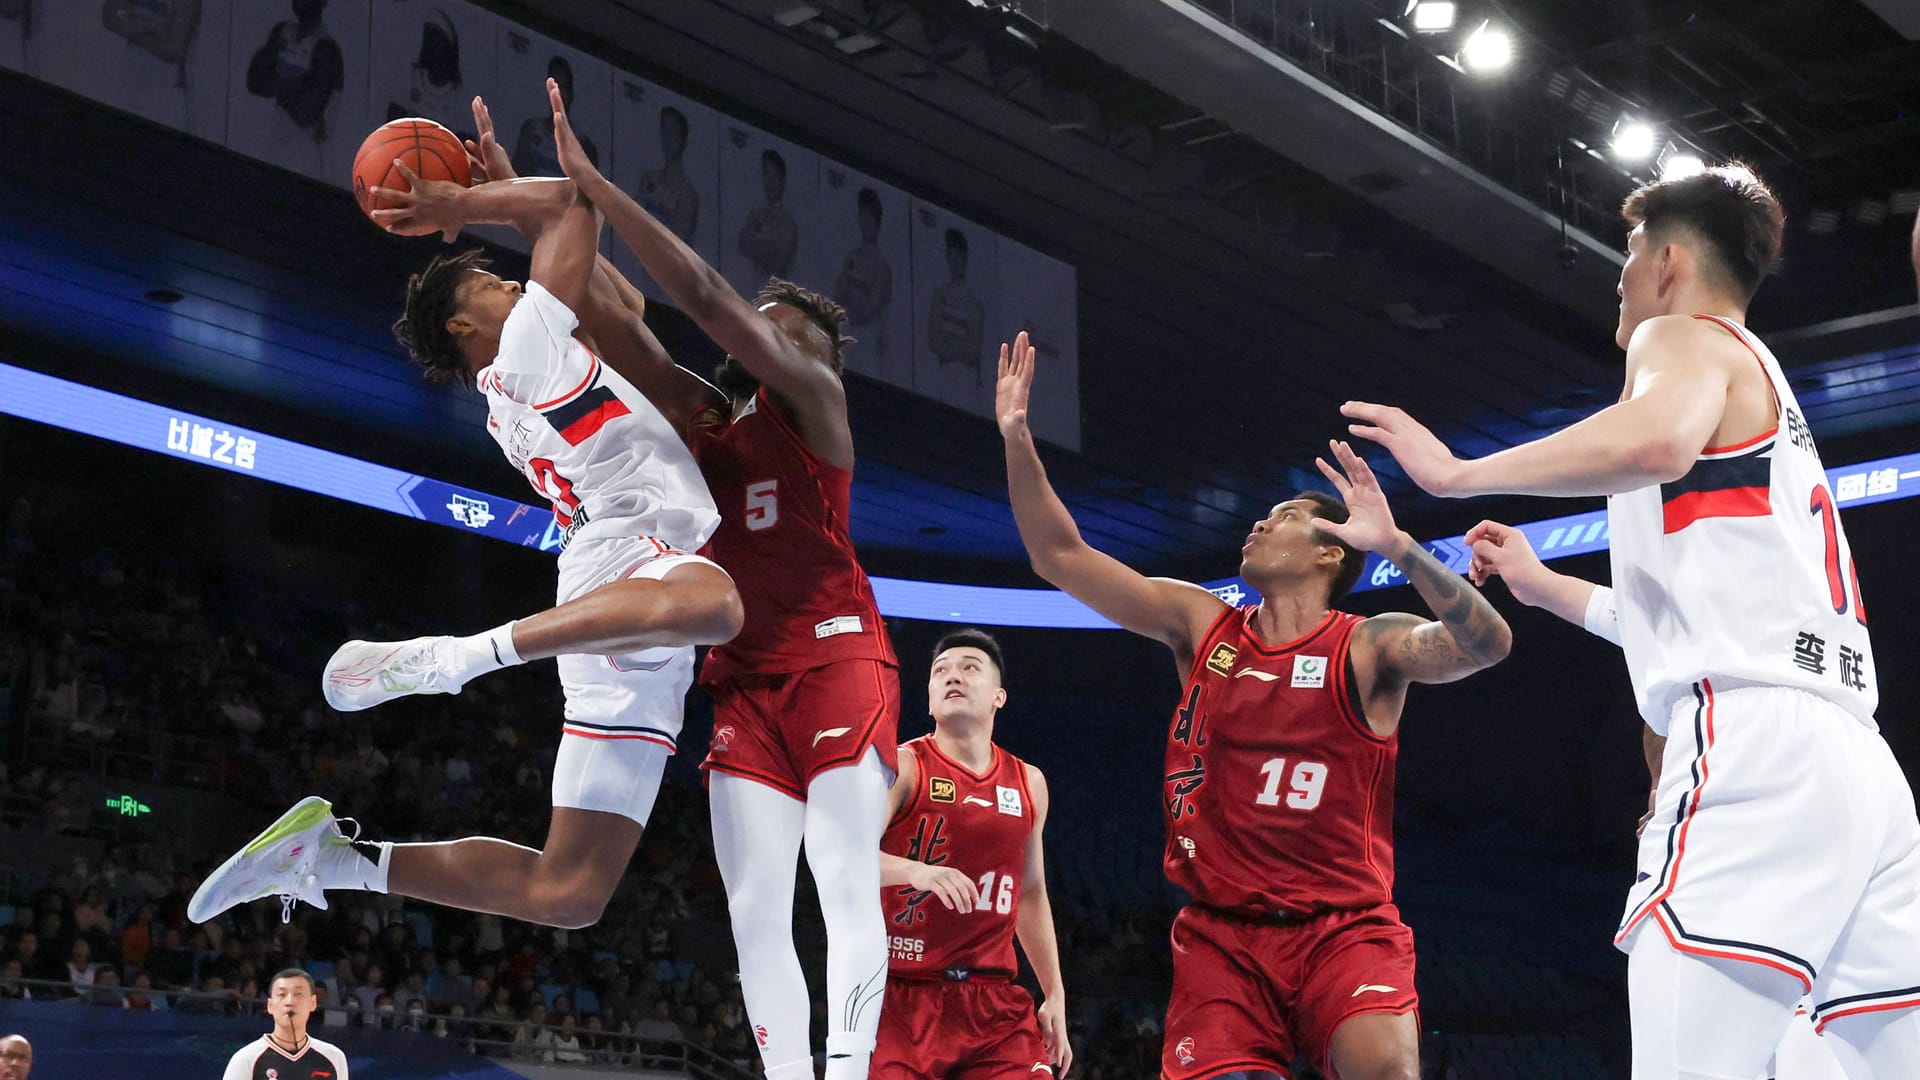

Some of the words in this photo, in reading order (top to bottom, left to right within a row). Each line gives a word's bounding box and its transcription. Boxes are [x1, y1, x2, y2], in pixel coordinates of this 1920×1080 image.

[167, 417, 256, 470] 以城之名
[745, 480, 778, 531] 5
[1256, 758, 1328, 810] 19
[976, 871, 1014, 914] 16
[888, 951, 924, 962] INCE
